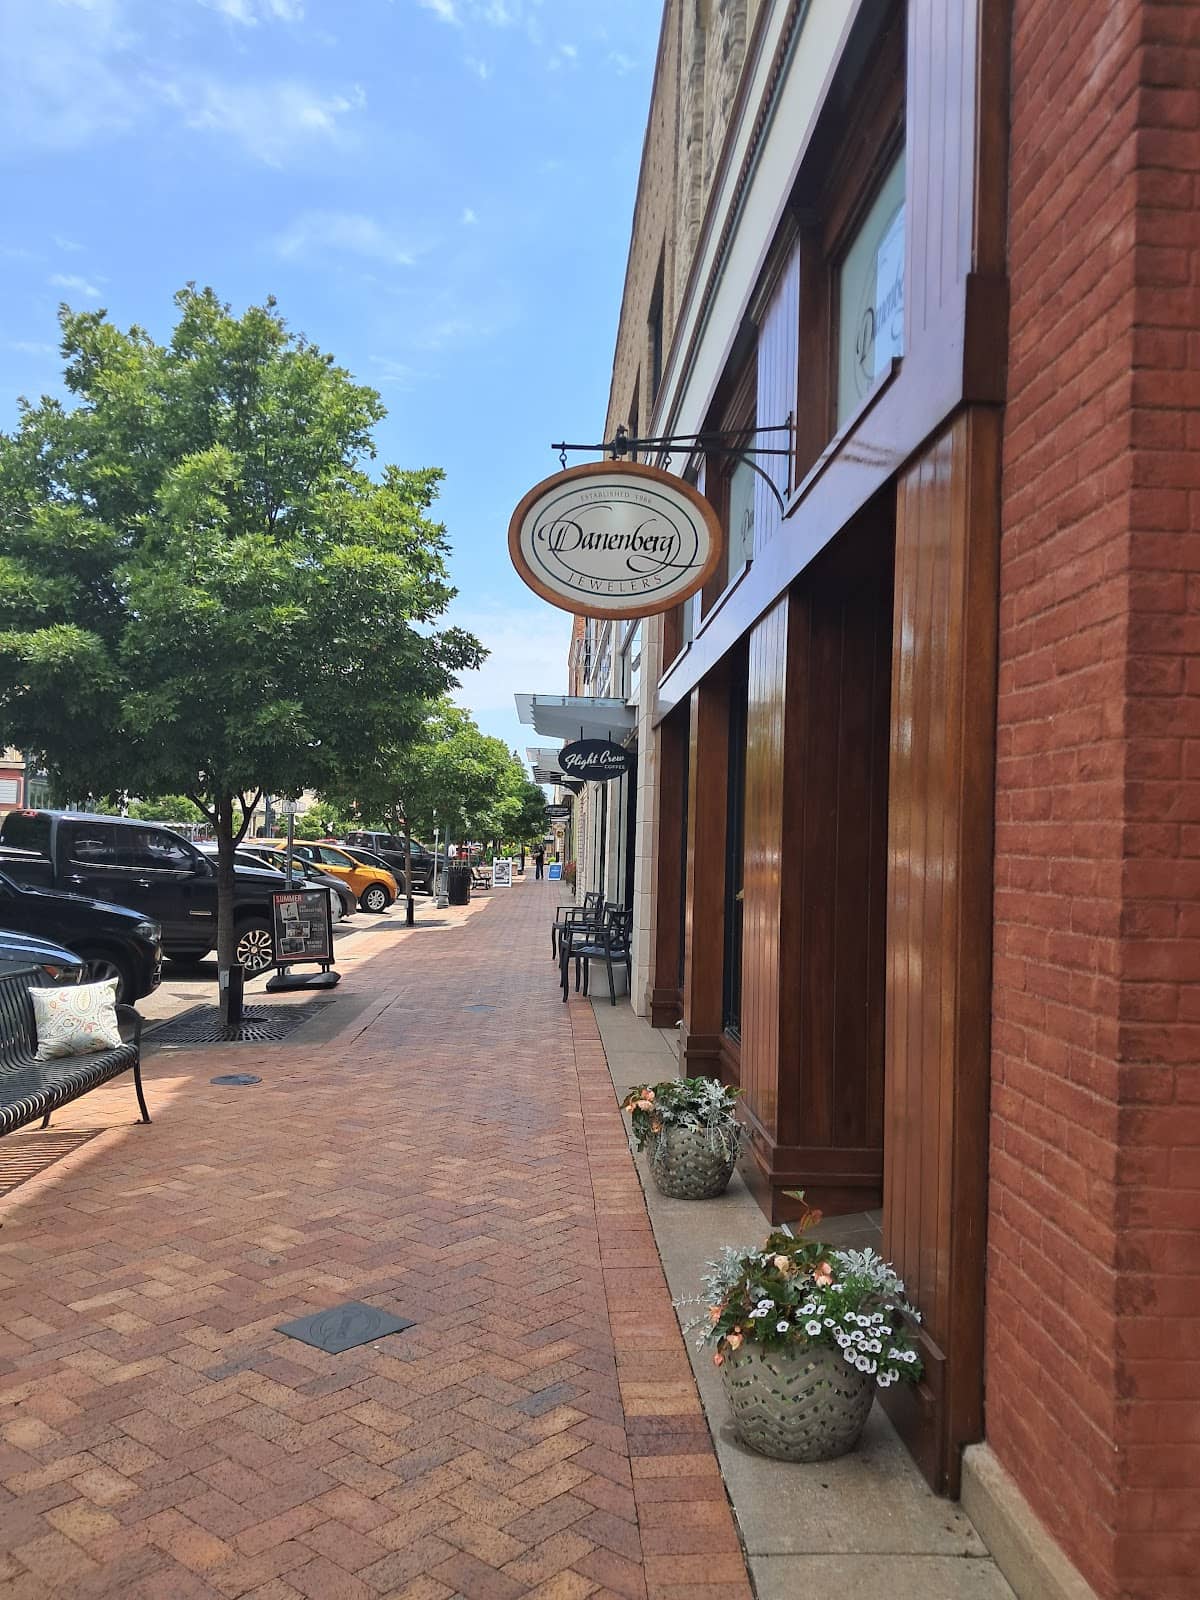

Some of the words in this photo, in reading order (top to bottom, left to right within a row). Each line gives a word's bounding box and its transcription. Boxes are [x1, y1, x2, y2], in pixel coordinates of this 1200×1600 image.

[580, 490, 630, 502] ESTABLISHED
[538, 506, 704, 573] Danenberg
[567, 572, 663, 593] JEWELERS
[564, 752, 598, 770] Flight
[600, 749, 625, 764] Crew
[275, 894, 302, 903] SUMMER
